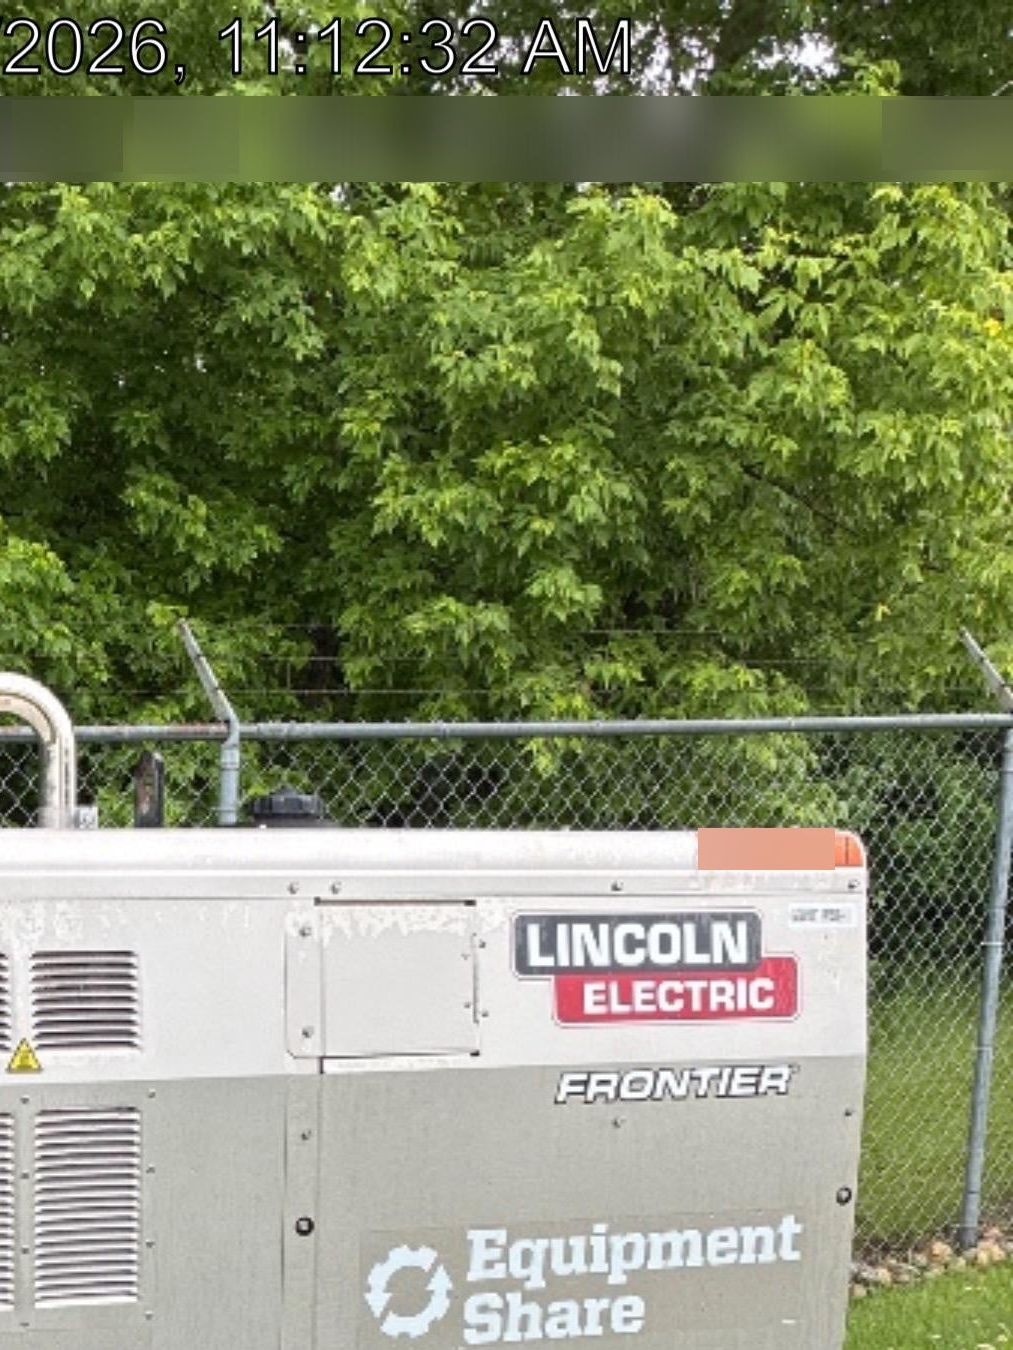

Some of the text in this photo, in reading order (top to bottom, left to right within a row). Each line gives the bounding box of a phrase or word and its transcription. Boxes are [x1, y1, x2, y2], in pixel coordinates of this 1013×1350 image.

[527, 922, 748, 967] LINCOLN
[583, 978, 775, 1015] ELECTRIC
[554, 1065, 791, 1104] FRONTIER
[466, 1215, 802, 1288] Equipment
[463, 1292, 645, 1345] Share
